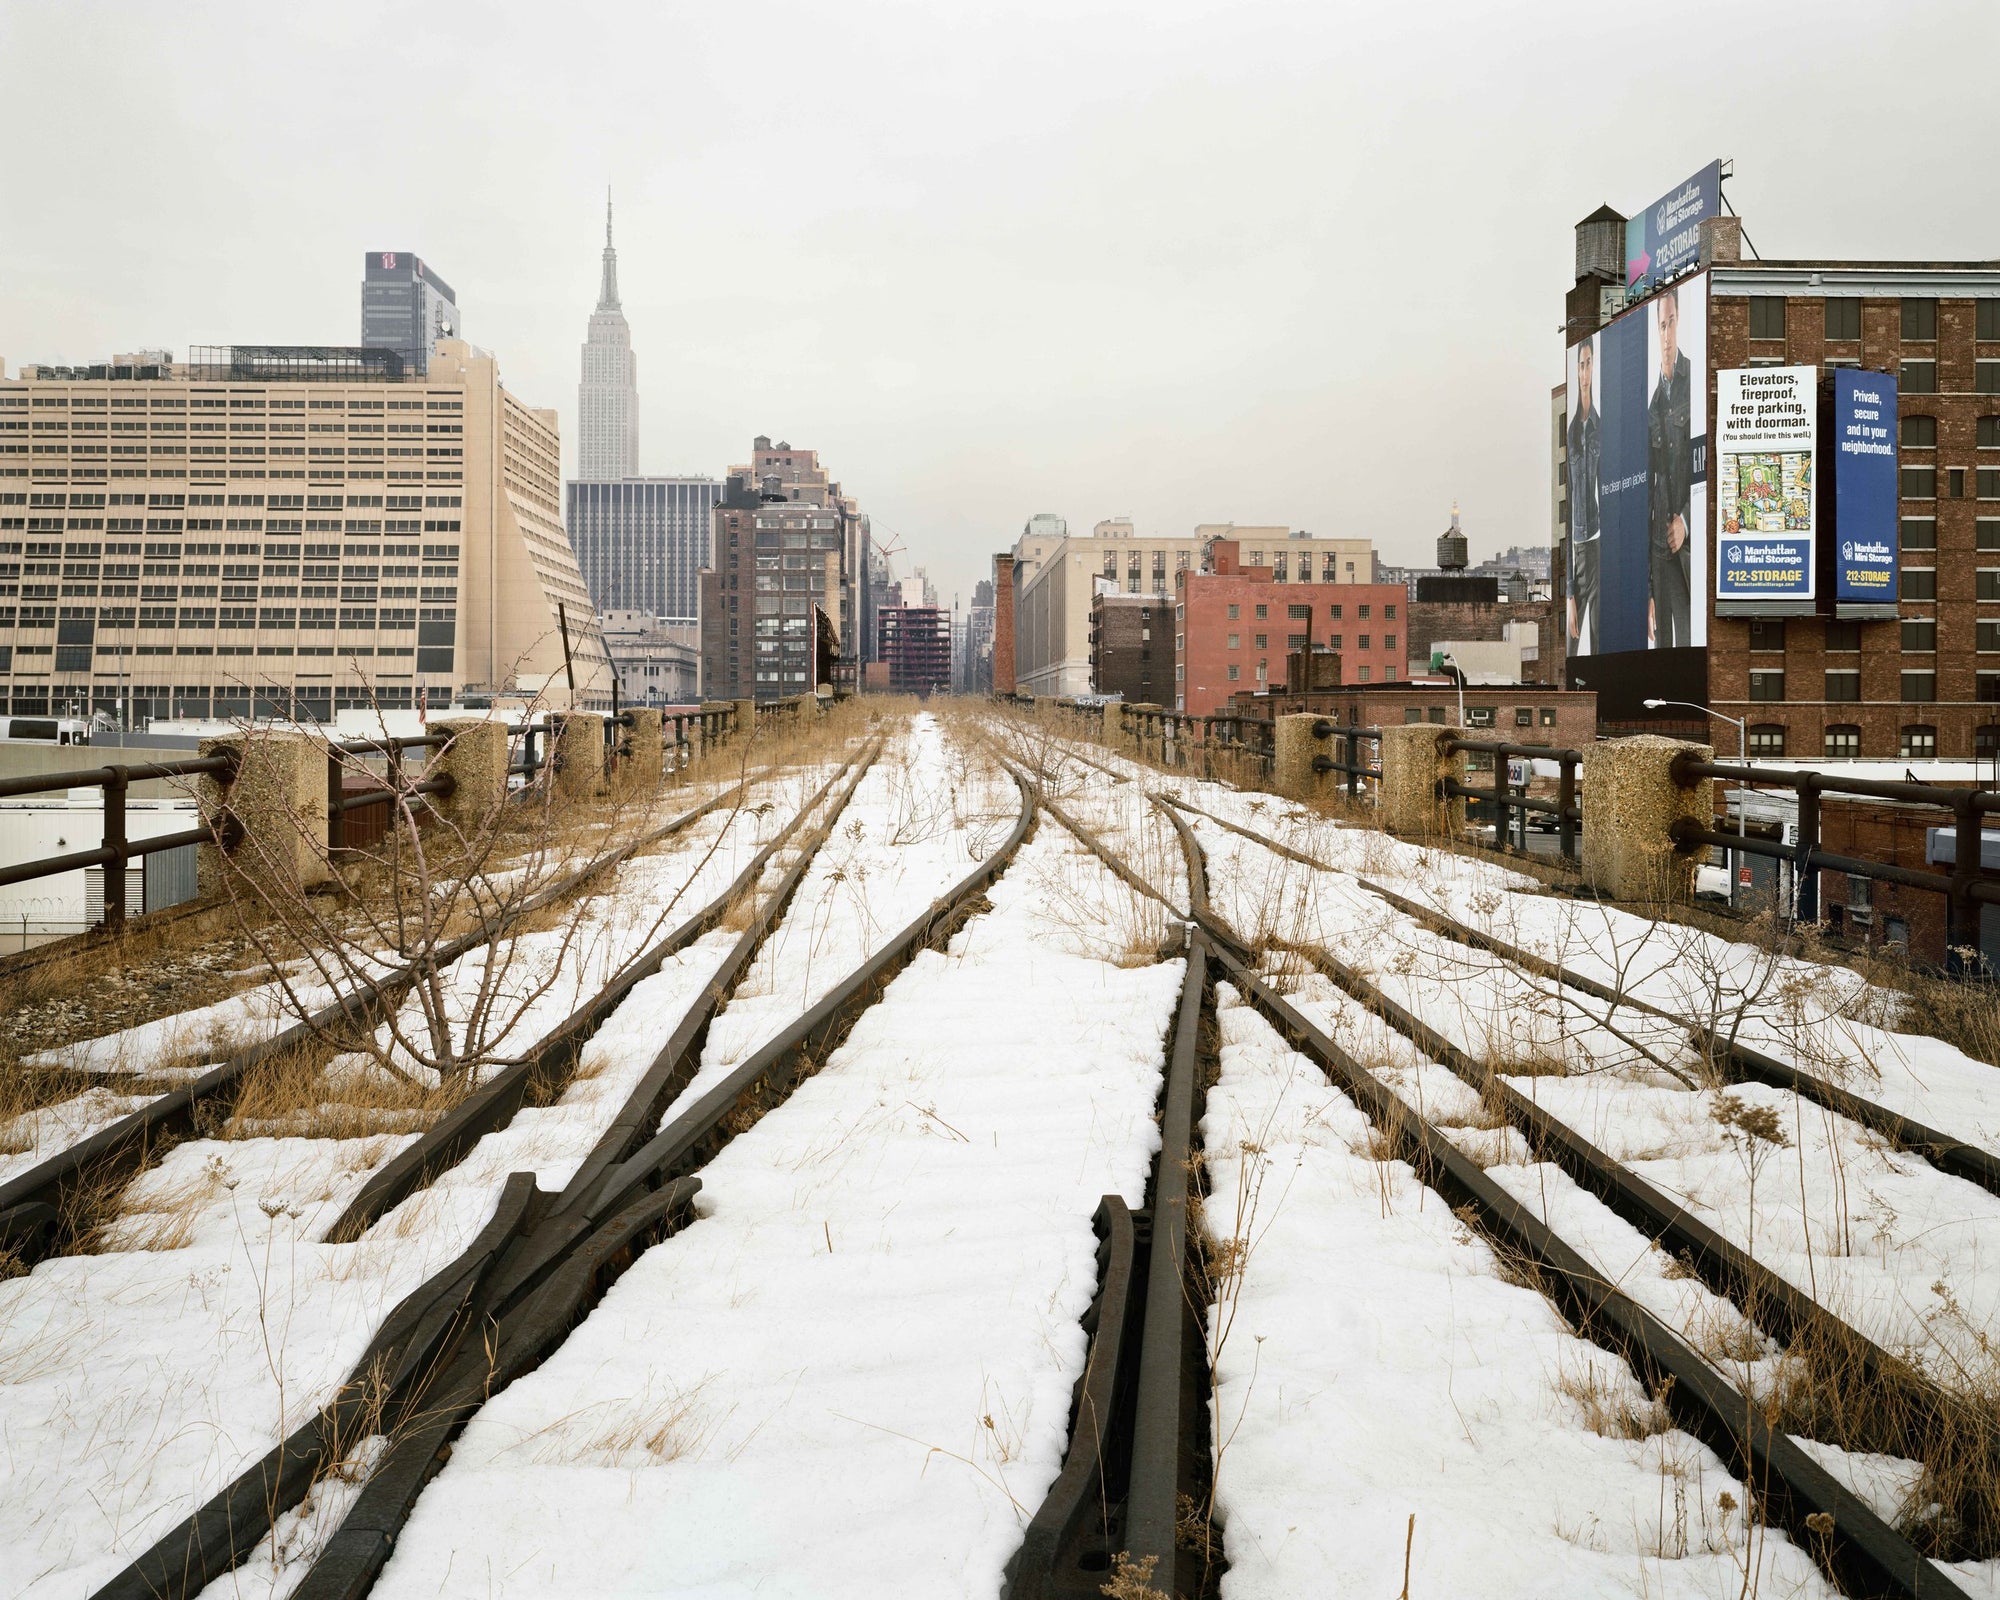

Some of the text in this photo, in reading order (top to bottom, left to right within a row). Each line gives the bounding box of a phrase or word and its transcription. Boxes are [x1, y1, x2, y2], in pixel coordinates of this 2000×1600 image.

[1667, 183, 1700, 216] Manhattan
[1666, 199, 1704, 232] Mini Storage
[1656, 224, 1699, 268] 212-STORAG
[1740, 374, 1799, 386] Elevators,
[1741, 387, 1797, 402] fireproof,
[1853, 389, 1882, 406] Private,
[1731, 402, 1807, 416] free parking,
[1854, 409, 1879, 421] secure
[1726, 417, 1810, 429] with doorman.
[1722, 433, 1738, 442] (You
[1739, 432, 1762, 440] should
[1763, 432, 1777, 440] live
[1778, 431, 1792, 439] this
[1846, 424, 1888, 440] and in your
[1842, 440, 1894, 455] neighborhood.
[1693, 446, 1706, 474] GAP
[1744, 544, 1797, 555] Manhattan
[1854, 541, 1890, 554] Manhattan
[1744, 555, 1802, 565] Mini Storage
[1854, 552, 1893, 565] Mini Storage
[1727, 570, 1803, 582] 212-STORAGE
[1846, 570, 1891, 583] 212-STORAGE
